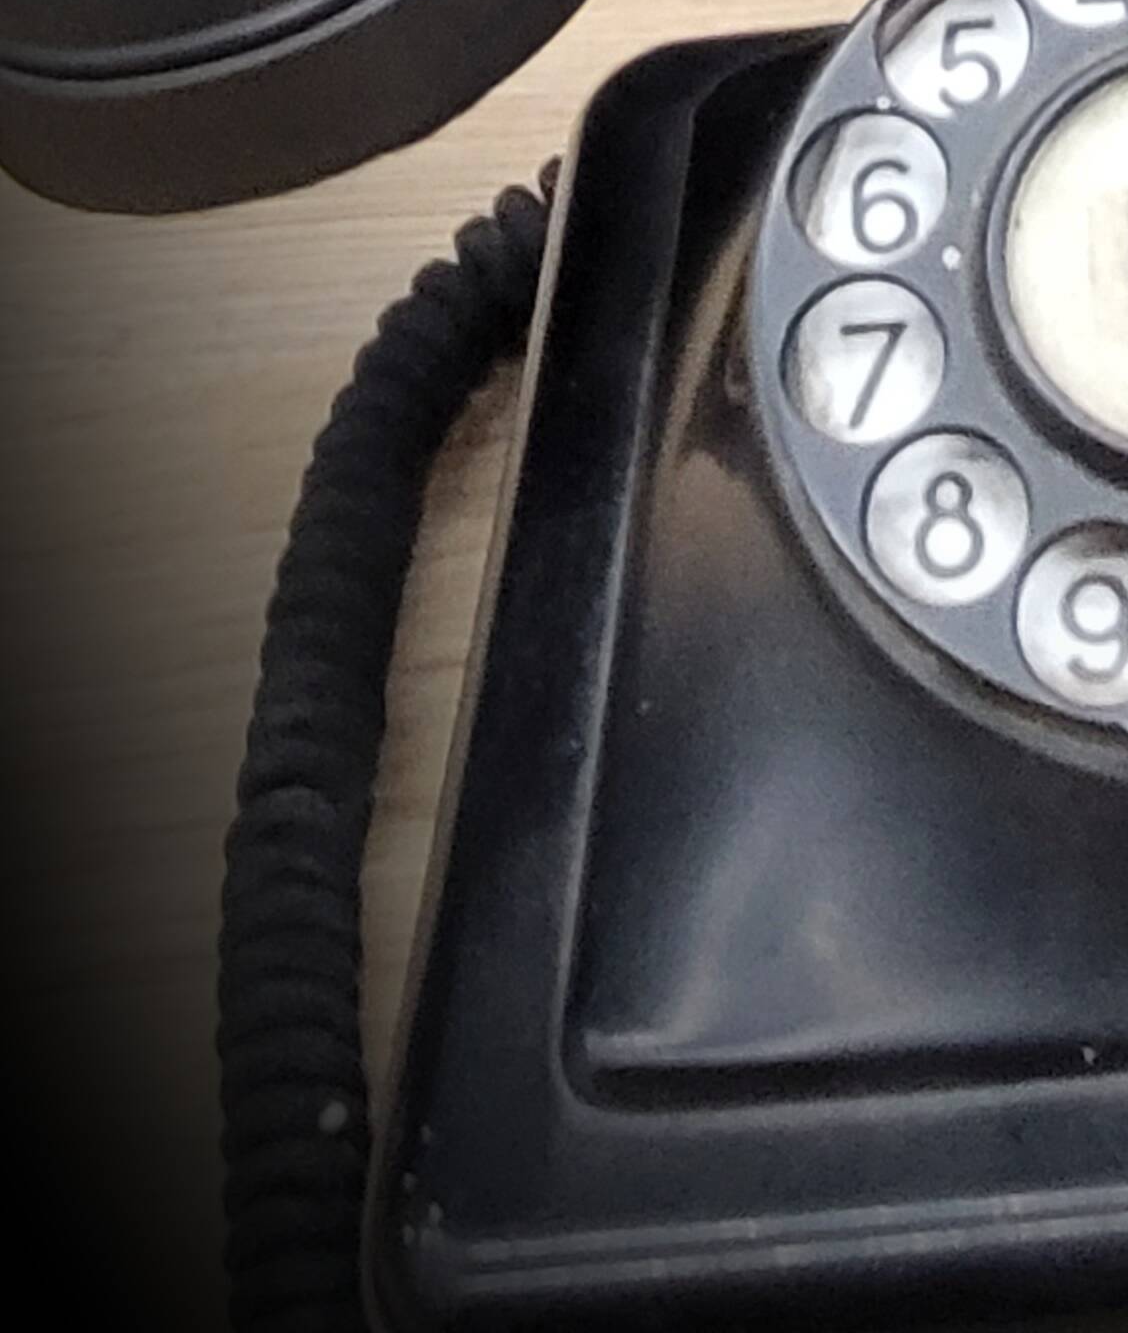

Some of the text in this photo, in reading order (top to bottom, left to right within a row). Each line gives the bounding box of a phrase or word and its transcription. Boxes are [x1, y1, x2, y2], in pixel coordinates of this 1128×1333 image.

[938, 19, 999, 109] 5
[851, 161, 920, 254] 6
[840, 323, 908, 428] 7
[916, 473, 984, 580] 8
